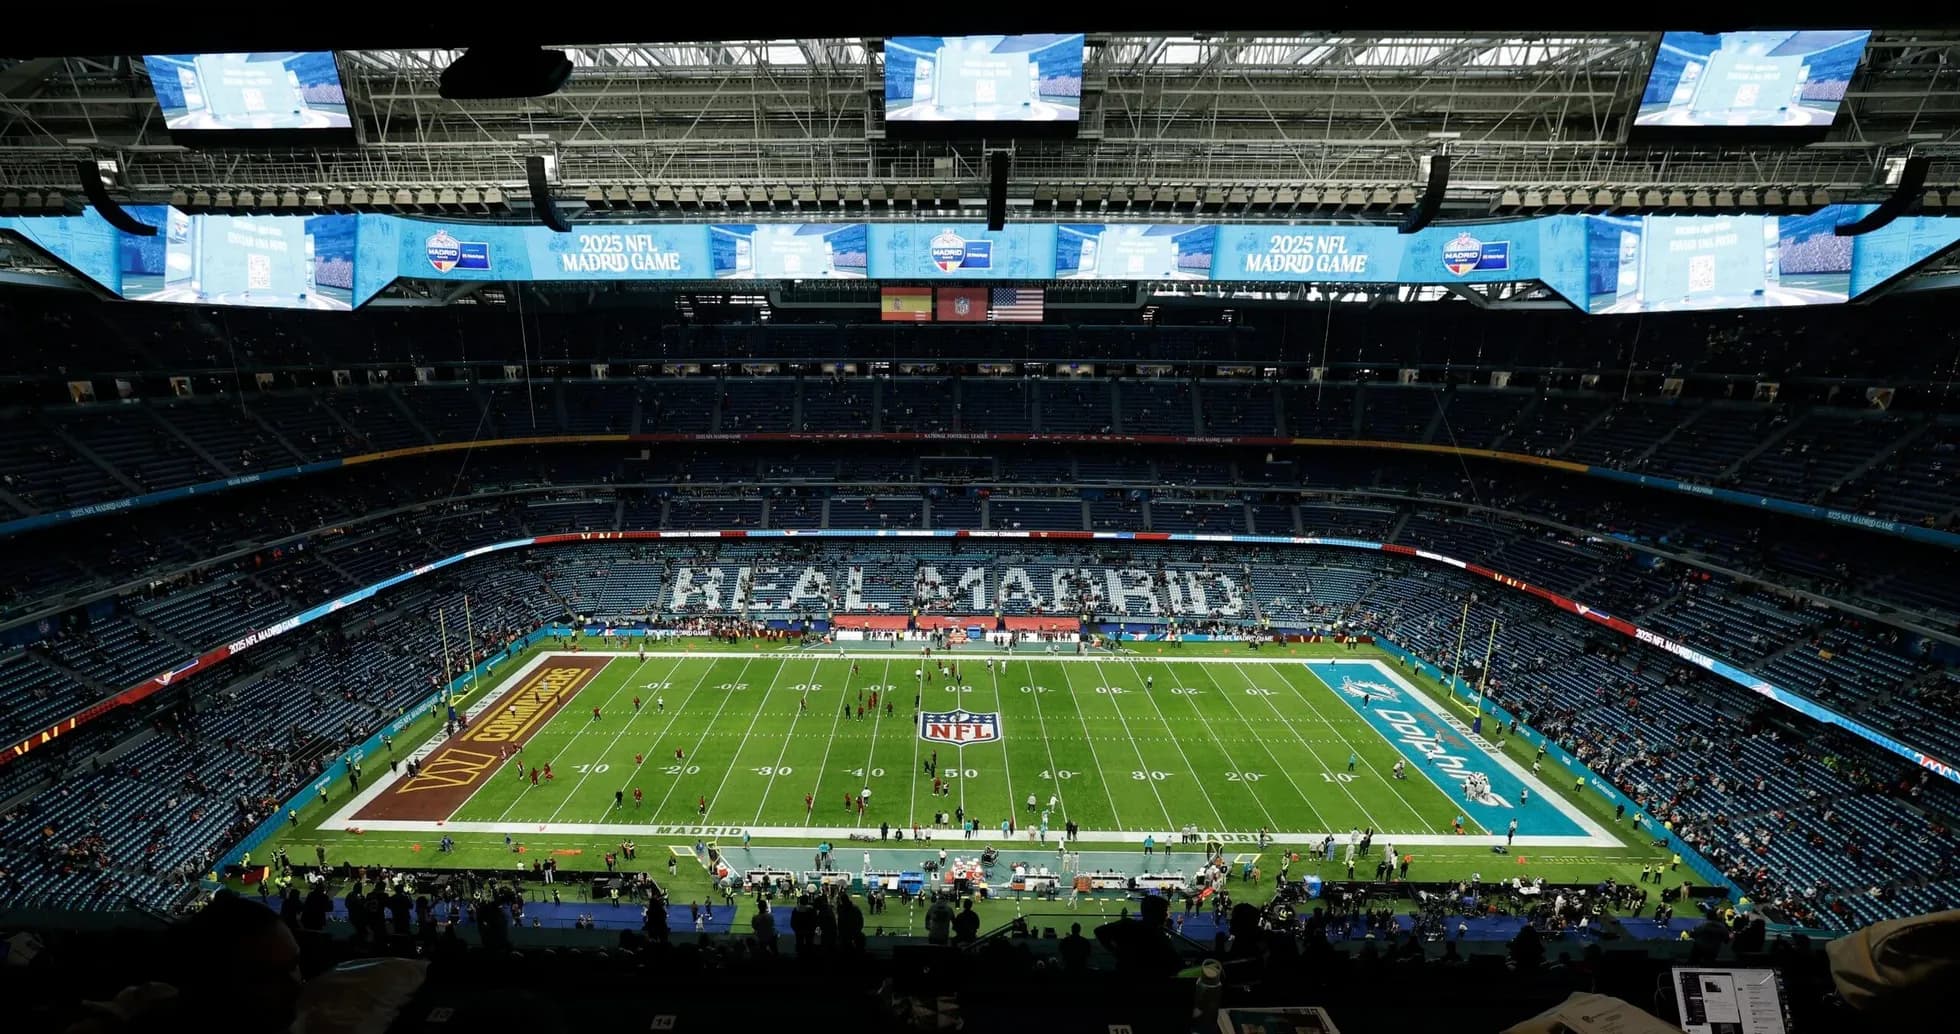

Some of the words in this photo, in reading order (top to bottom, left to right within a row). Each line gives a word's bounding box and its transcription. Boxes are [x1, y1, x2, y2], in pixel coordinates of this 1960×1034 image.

[579, 235, 623, 253] 2025
[625, 235, 658, 253] NFL
[1269, 235, 1314, 253] 2025
[1315, 235, 1348, 253] NFL
[428, 248, 458, 256] MADRID
[562, 253, 629, 272] MADRID
[631, 253, 680, 271] GAME
[1245, 254, 1314, 273] MADRID
[1316, 254, 1368, 272] GAME
[1841, 513, 1851, 522] NFL
[1852, 515, 1875, 527] MADRID
[1875, 520, 1895, 531] GAME
[670, 567, 890, 611] REAL
[913, 567, 1245, 616] MADRID
[228, 640, 246, 655] 2025
[245, 634, 258, 647] NFL
[258, 623, 282, 642] MADRID
[282, 616, 298, 629] GAME
[1635, 628, 1653, 642] 2025
[1652, 635, 1665, 649] NFL
[1665, 640, 1692, 660] MADRID
[1692, 652, 1714, 670] GAME
[473, 667, 582, 742] COMMANDERS
[928, 723, 992, 740] NFL
[1374, 707, 1515, 809] Dolphis
[577, 764, 610, 773] 10
[665, 765, 700, 775] 20
[758, 766, 792, 776] 30
[851, 768, 885, 777] 40
[944, 768, 978, 778] 50
[1038, 770, 1072, 779] 40
[1132, 770, 1165, 780] 30
[1225, 771, 1259, 781] 20
[1320, 773, 1352, 782] 10
[656, 826, 742, 835] MADRID
